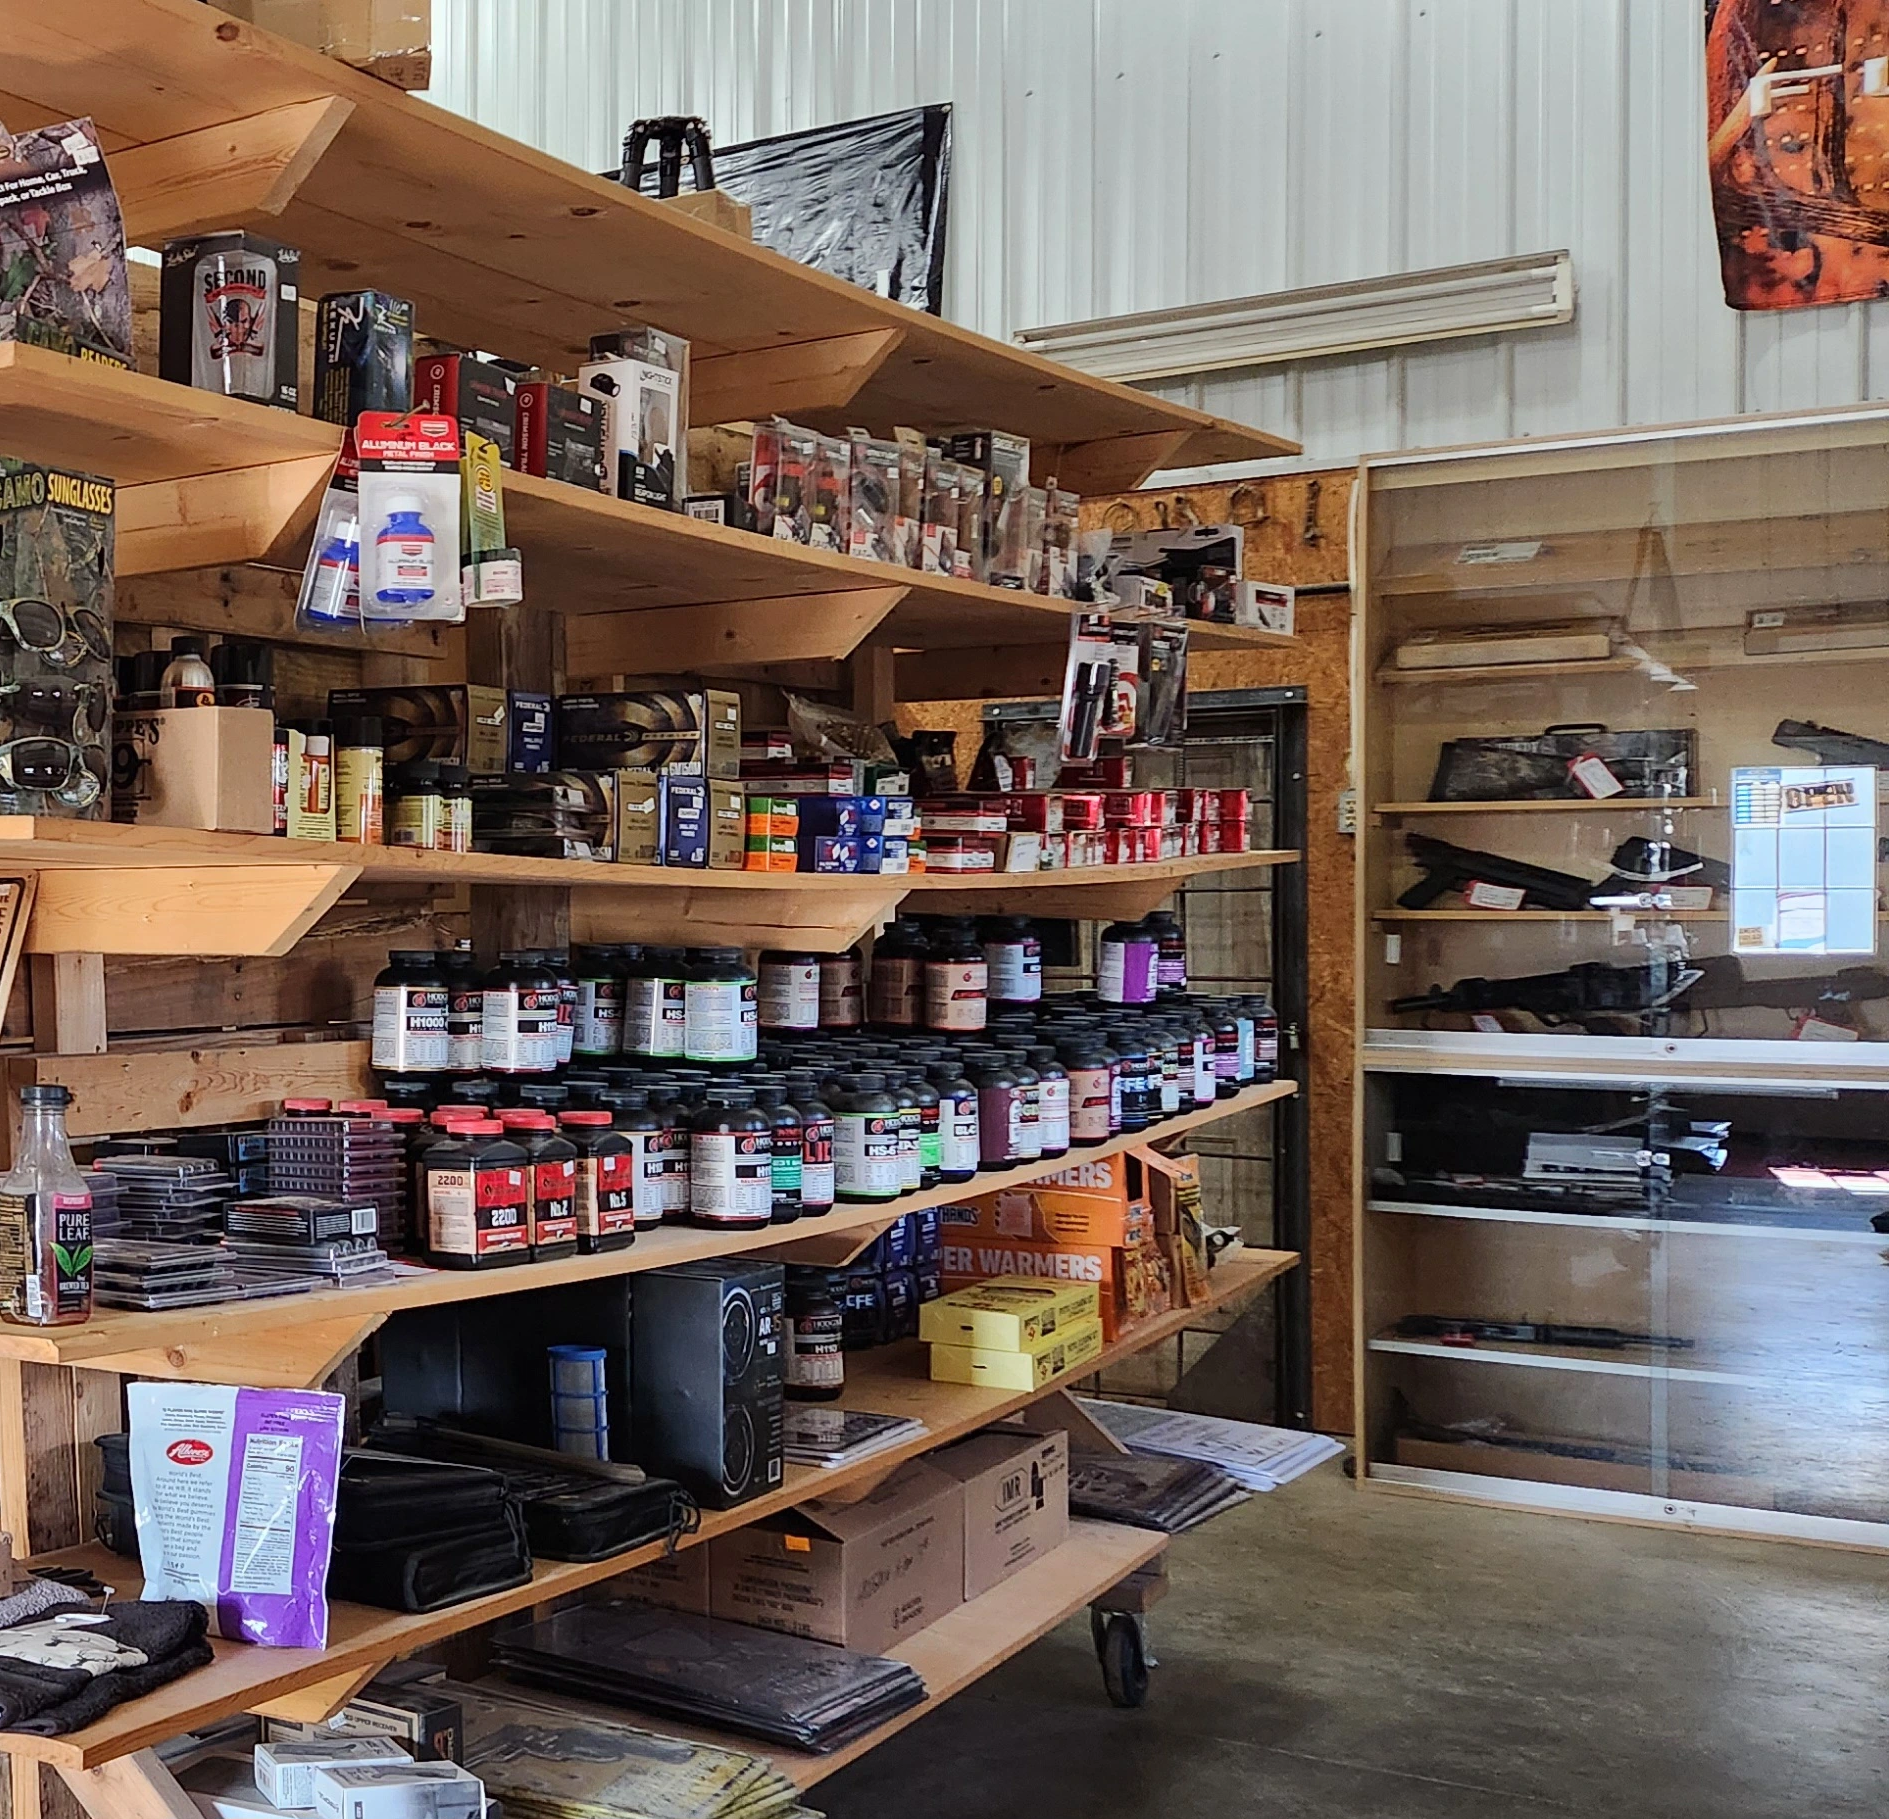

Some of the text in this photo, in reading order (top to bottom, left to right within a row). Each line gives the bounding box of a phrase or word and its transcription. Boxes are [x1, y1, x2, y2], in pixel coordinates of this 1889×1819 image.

[5, 180, 18, 192] For
[56, 182, 73, 195] Box
[204, 269, 266, 292] SECOND
[362, 440, 456, 451] ALUMINUM BLACK
[383, 450, 408, 459] METAL
[47, 472, 113, 515] SUNGLASSES
[515, 701, 543, 710] FEDERAL
[563, 734, 621, 743] FEDERAL
[671, 786, 696, 795] FEDERAL
[411, 1017, 445, 1028] H1000
[868, 1146, 897, 1156] HS-6
[438, 1175, 464, 1186] 2200
[59, 1213, 90, 1227] PURE
[491, 1207, 518, 1226] 2200
[979, 1249, 1102, 1281] WARMERS
[846, 1295, 873, 1309] CFE
[815, 1345, 838, 1354] H110
